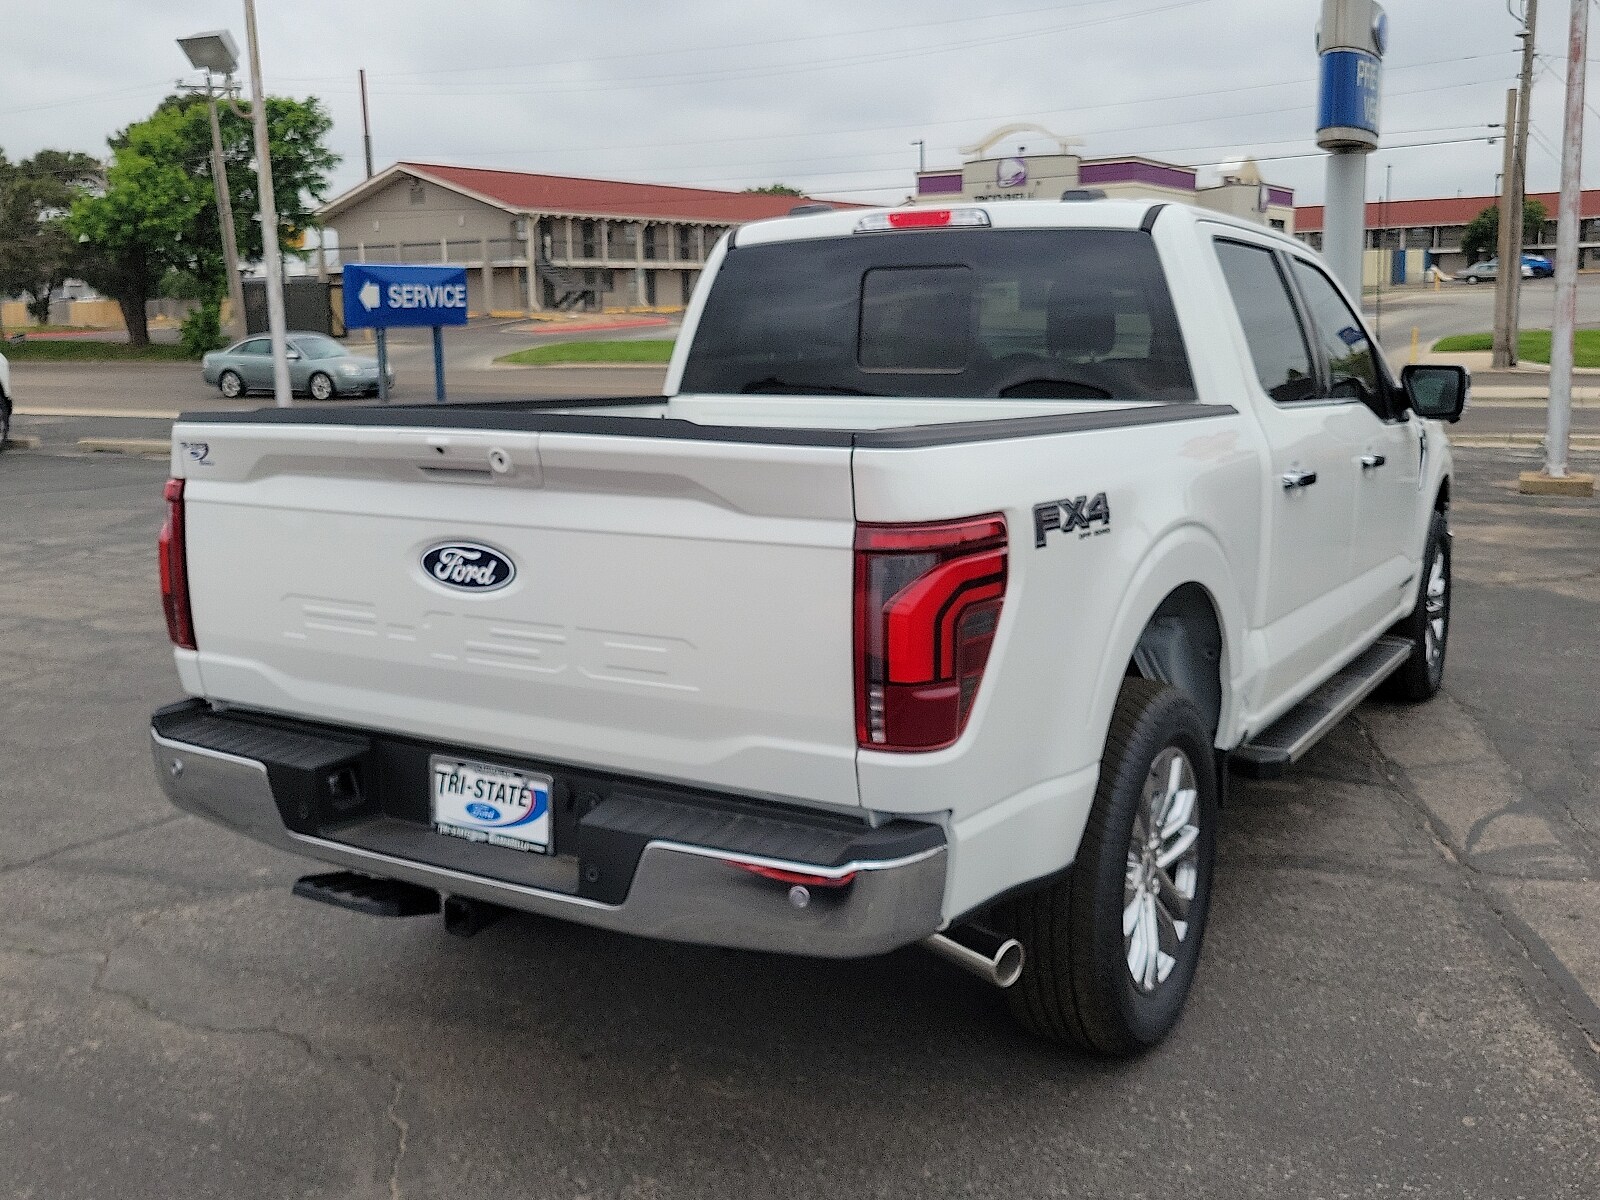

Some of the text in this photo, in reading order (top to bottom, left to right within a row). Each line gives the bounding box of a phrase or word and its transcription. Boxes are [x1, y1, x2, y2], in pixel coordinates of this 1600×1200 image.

[388, 283, 466, 308] SERVICE
[1032, 492, 1109, 548] FX4
[434, 548, 497, 585] Ford
[436, 771, 531, 807] TRI-STATE
